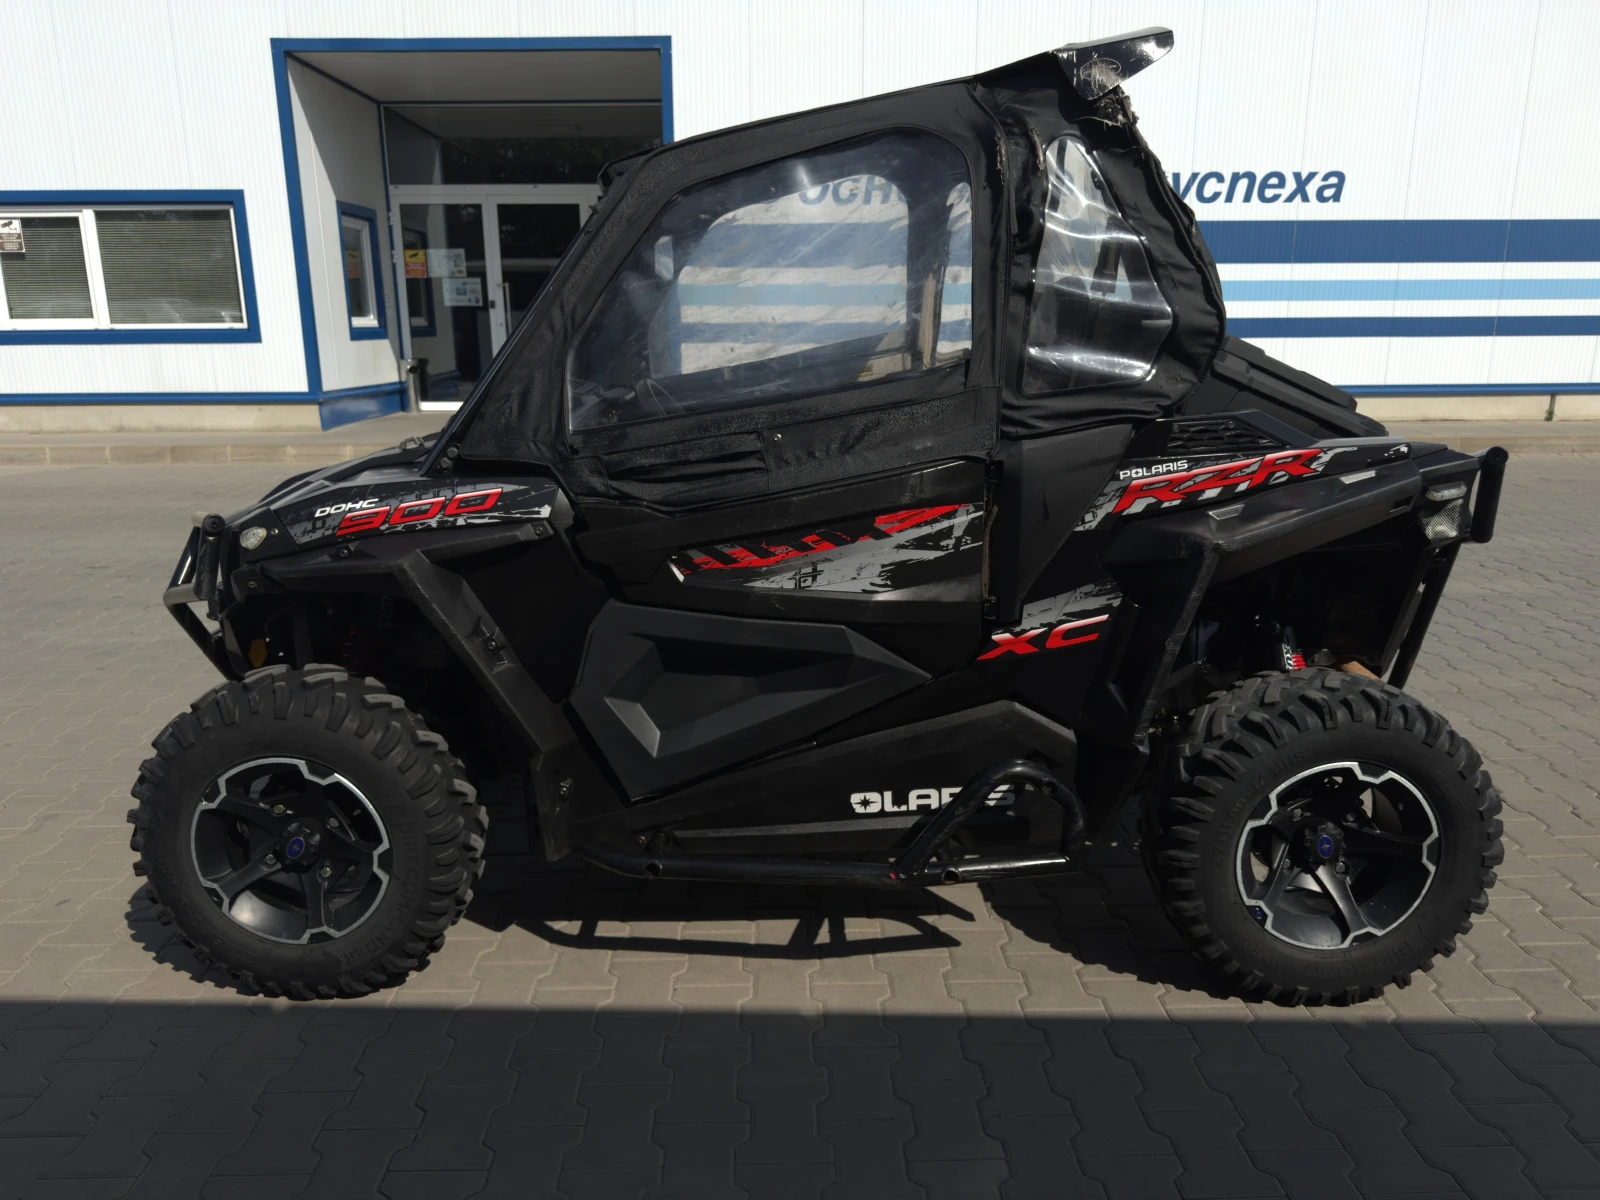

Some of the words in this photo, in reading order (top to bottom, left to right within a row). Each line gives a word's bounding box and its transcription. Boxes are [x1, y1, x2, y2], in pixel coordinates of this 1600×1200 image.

[1112, 448, 1323, 514] RZR
[1119, 459, 1188, 480] POLARIS
[314, 498, 379, 518] DOHC
[335, 488, 503, 536] 900
[976, 613, 1110, 661] XC
